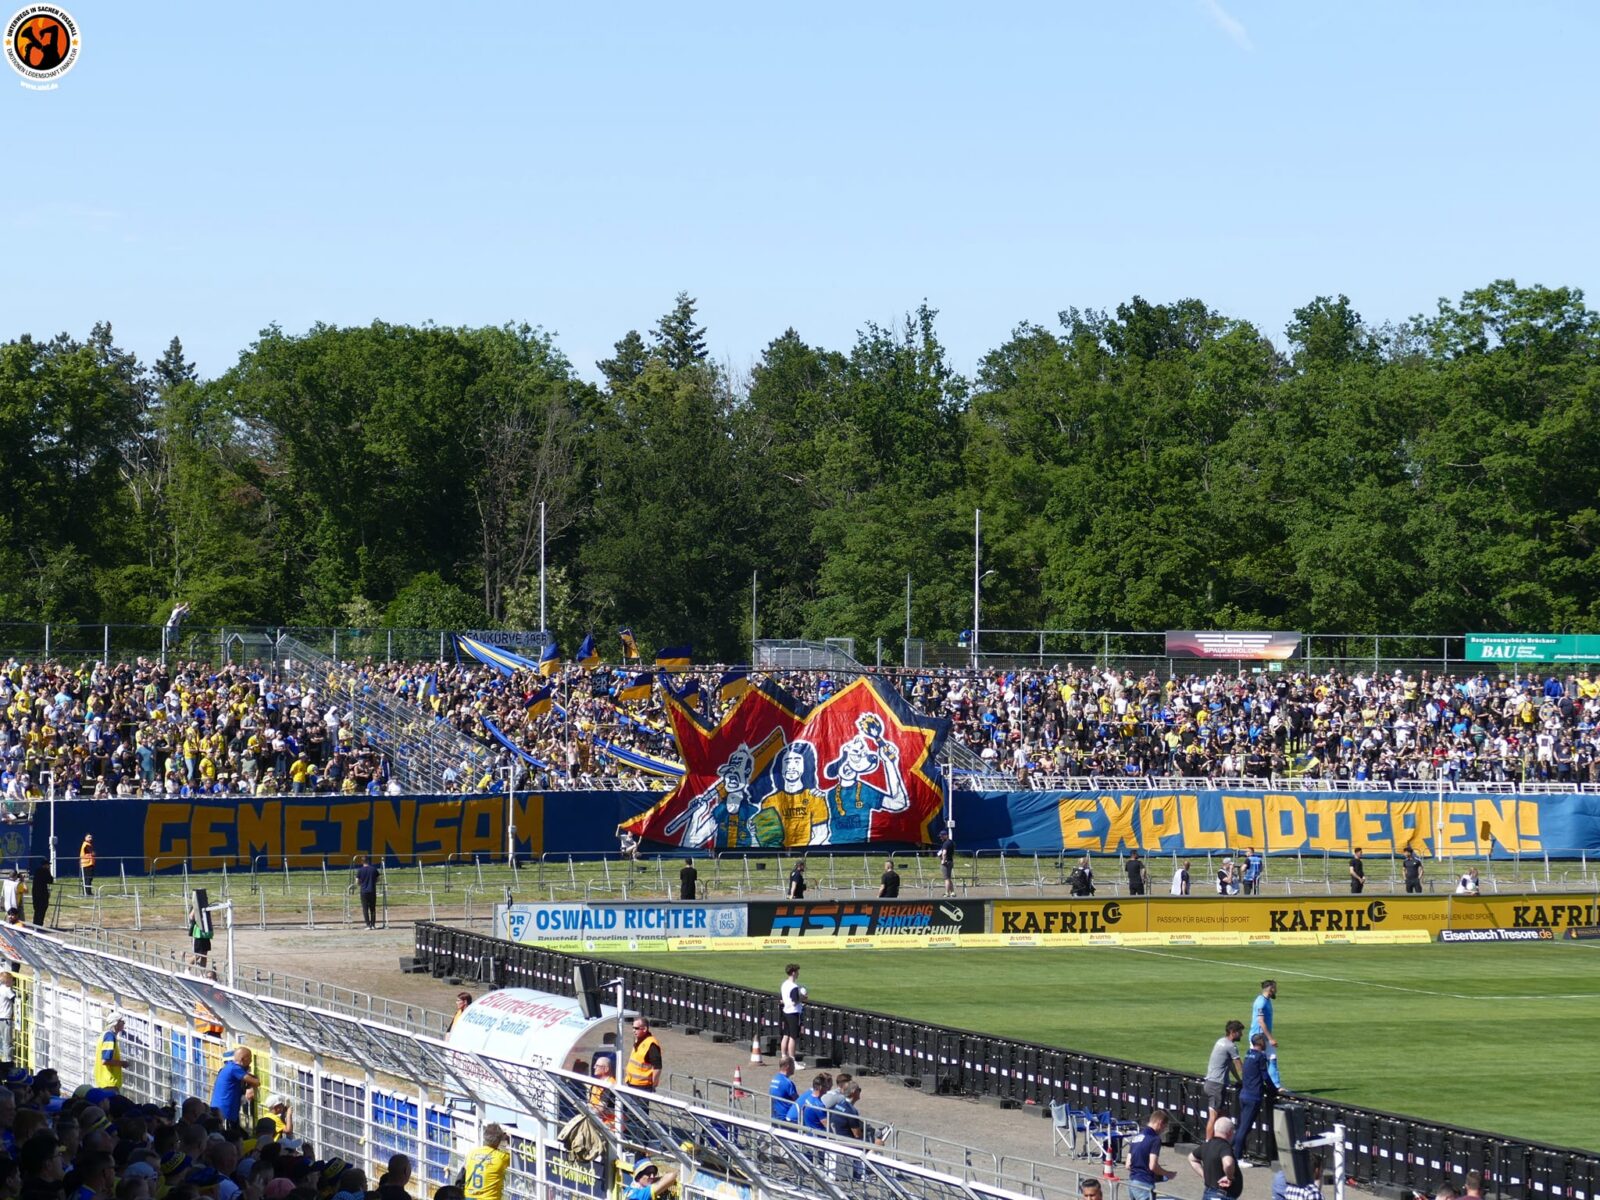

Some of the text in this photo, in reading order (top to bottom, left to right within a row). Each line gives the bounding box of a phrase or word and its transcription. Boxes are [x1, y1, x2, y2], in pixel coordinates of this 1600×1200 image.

[1481, 645, 1517, 658] BAU
[1058, 794, 1542, 857] EXPLODIEREN!
[144, 795, 544, 873] GEMEINSAM
[720, 911, 733, 920] seit
[880, 905, 934, 916] HEIZUNG
[1428, 912, 1440, 920] FÜR
[1475, 912, 1494, 920] SPORT
[1513, 905, 1600, 927] KAFRI
[536, 908, 707, 930] OSWALD RICHTER
[719, 919, 735, 929] 1865
[876, 913, 931, 927] SANITÄR
[1002, 911, 1106, 934] KAFRIL
[1183, 915, 1195, 923] FÜR
[1269, 909, 1371, 932] KAFRIL
[513, 927, 520, 937] S
[875, 925, 962, 936] HAUSTECHNIK
[1442, 928, 1553, 941] Eisenbach Tresore.de
[477, 992, 573, 1029] Blumenberg
[463, 1008, 531, 1036] Heizung Sanitär
[472, 1163, 484, 1188] 6
